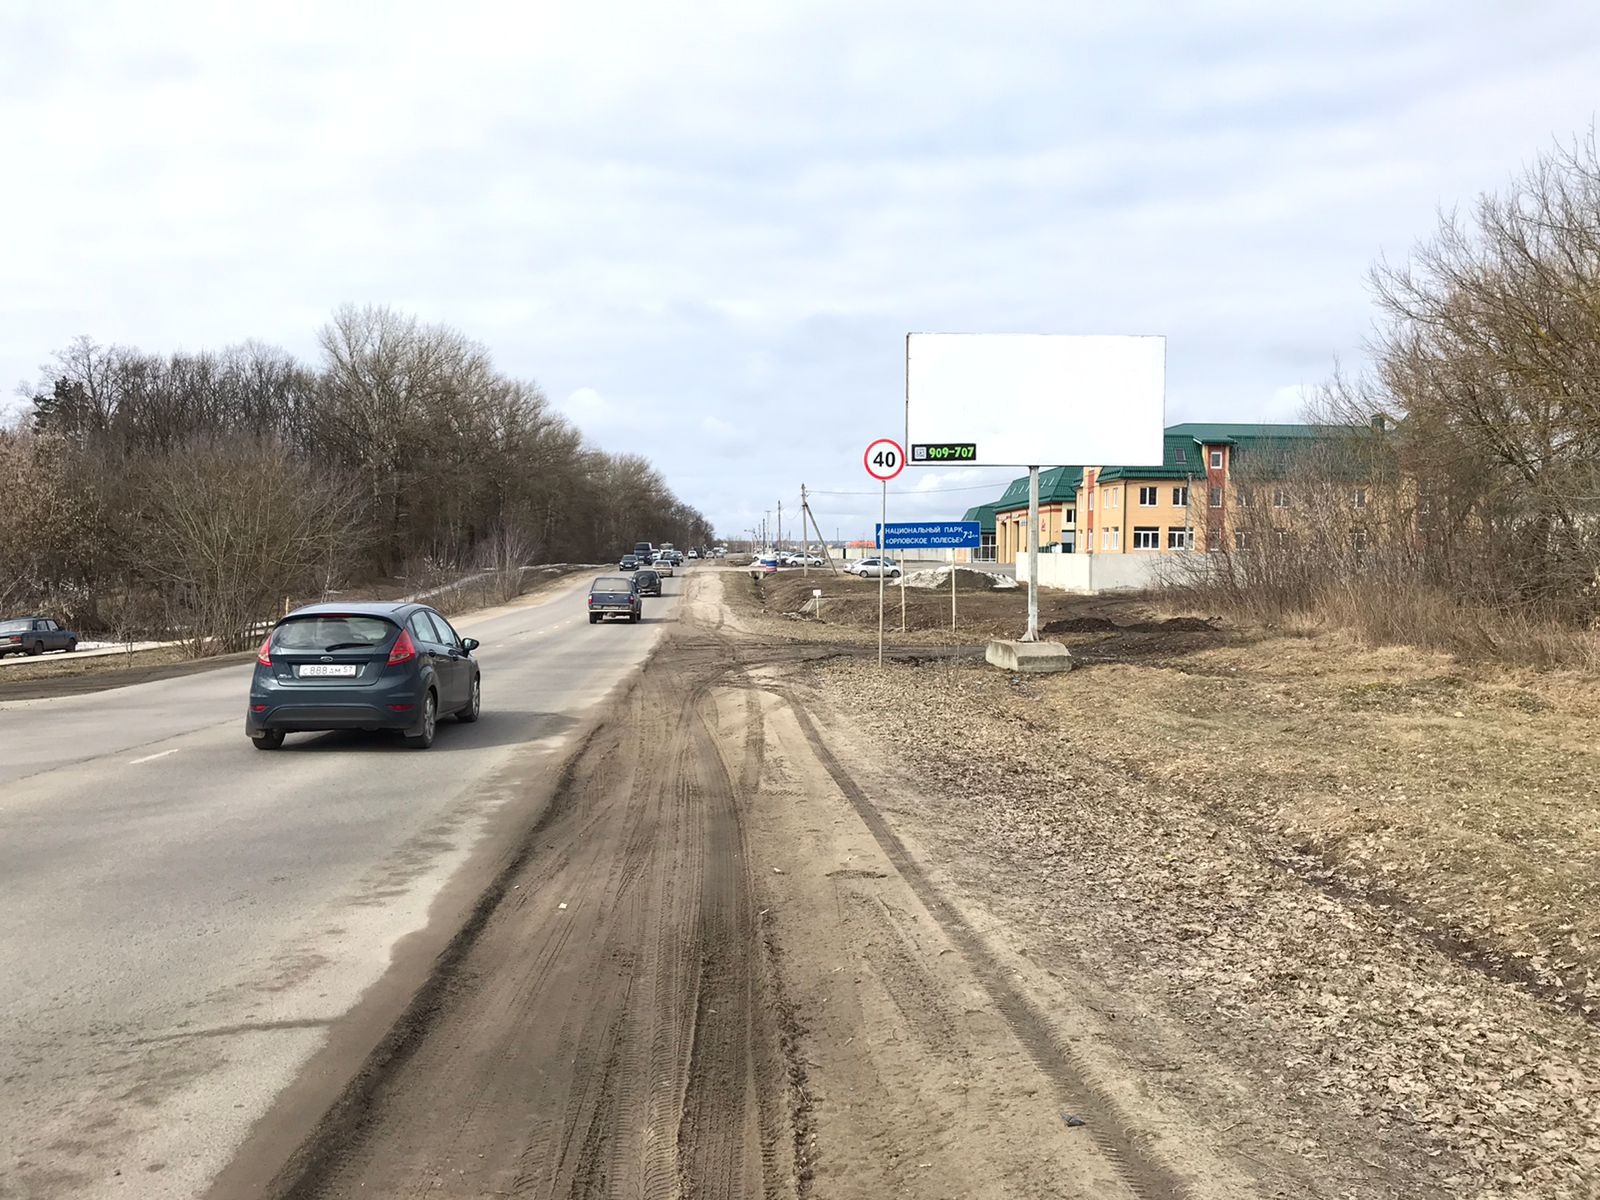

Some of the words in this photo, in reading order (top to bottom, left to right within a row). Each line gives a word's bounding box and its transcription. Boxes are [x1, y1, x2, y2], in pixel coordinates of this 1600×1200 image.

[929, 447, 974, 458] 909-707
[873, 451, 895, 467] 40
[885, 526, 941, 535] НАЦИОНАЛЬНЫЙ
